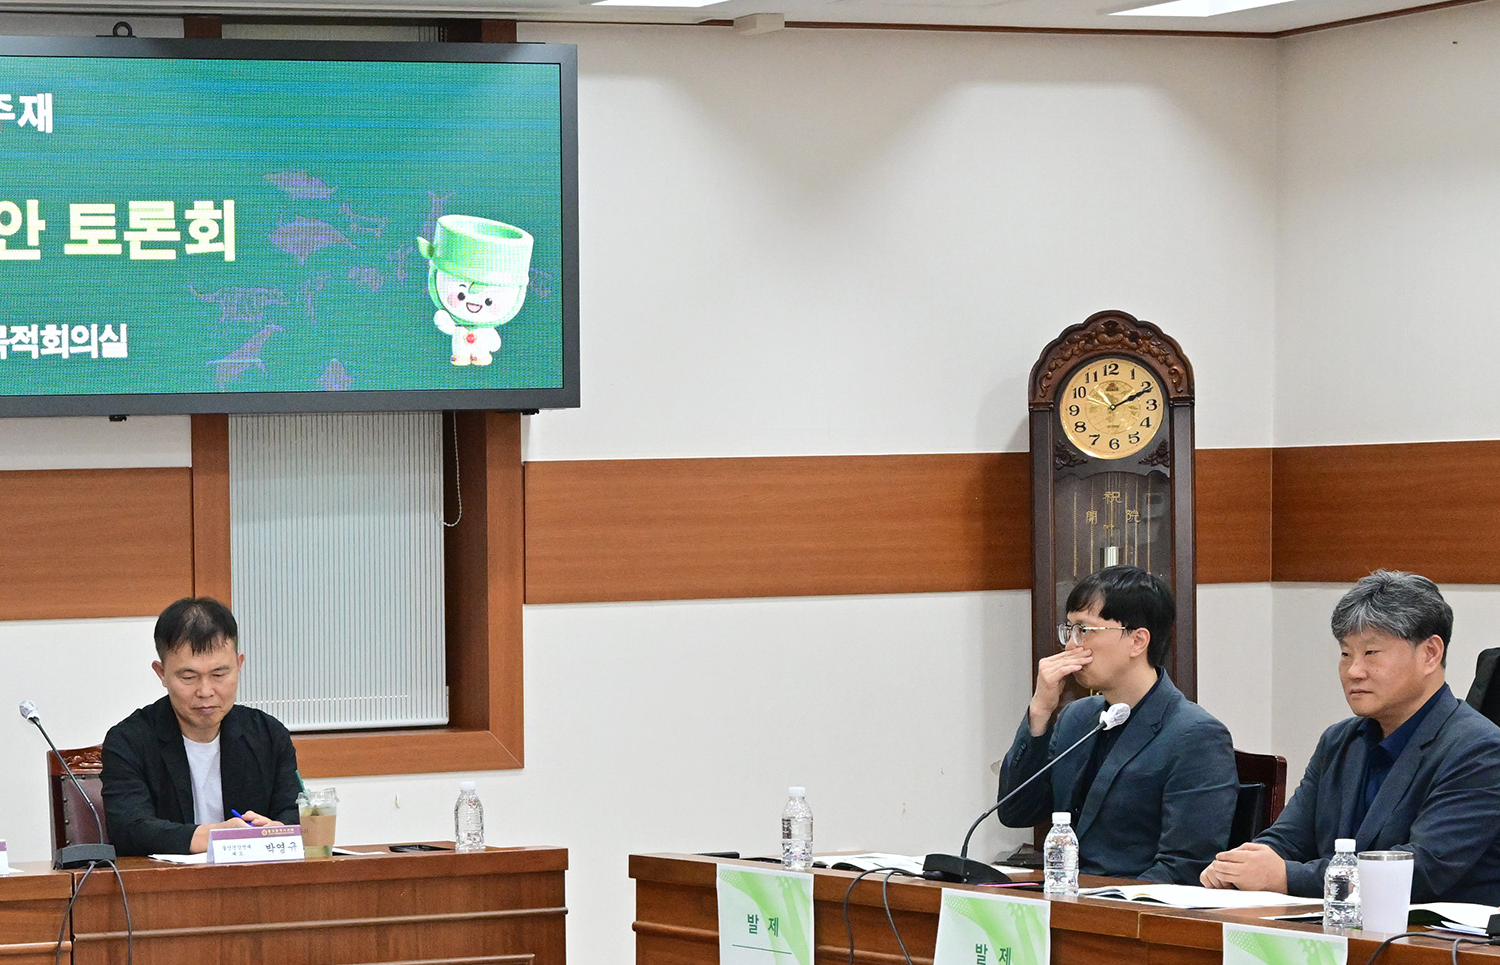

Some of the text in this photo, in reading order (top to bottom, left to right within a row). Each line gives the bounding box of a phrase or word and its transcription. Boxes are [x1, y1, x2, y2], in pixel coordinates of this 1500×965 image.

[64, 199, 237, 262] 토론회
[1103, 363, 1119, 376] 12
[1130, 367, 1136, 379] 1
[1085, 371, 1098, 383] 11
[1073, 387, 1086, 399] 10
[1069, 405, 1080, 416] 9
[1146, 399, 1157, 411] 3
[1074, 421, 1086, 433] 8
[1140, 417, 1152, 428] 4
[1089, 434, 1101, 445] 7
[1129, 431, 1140, 444] 5
[1109, 438, 1120, 450] 6
